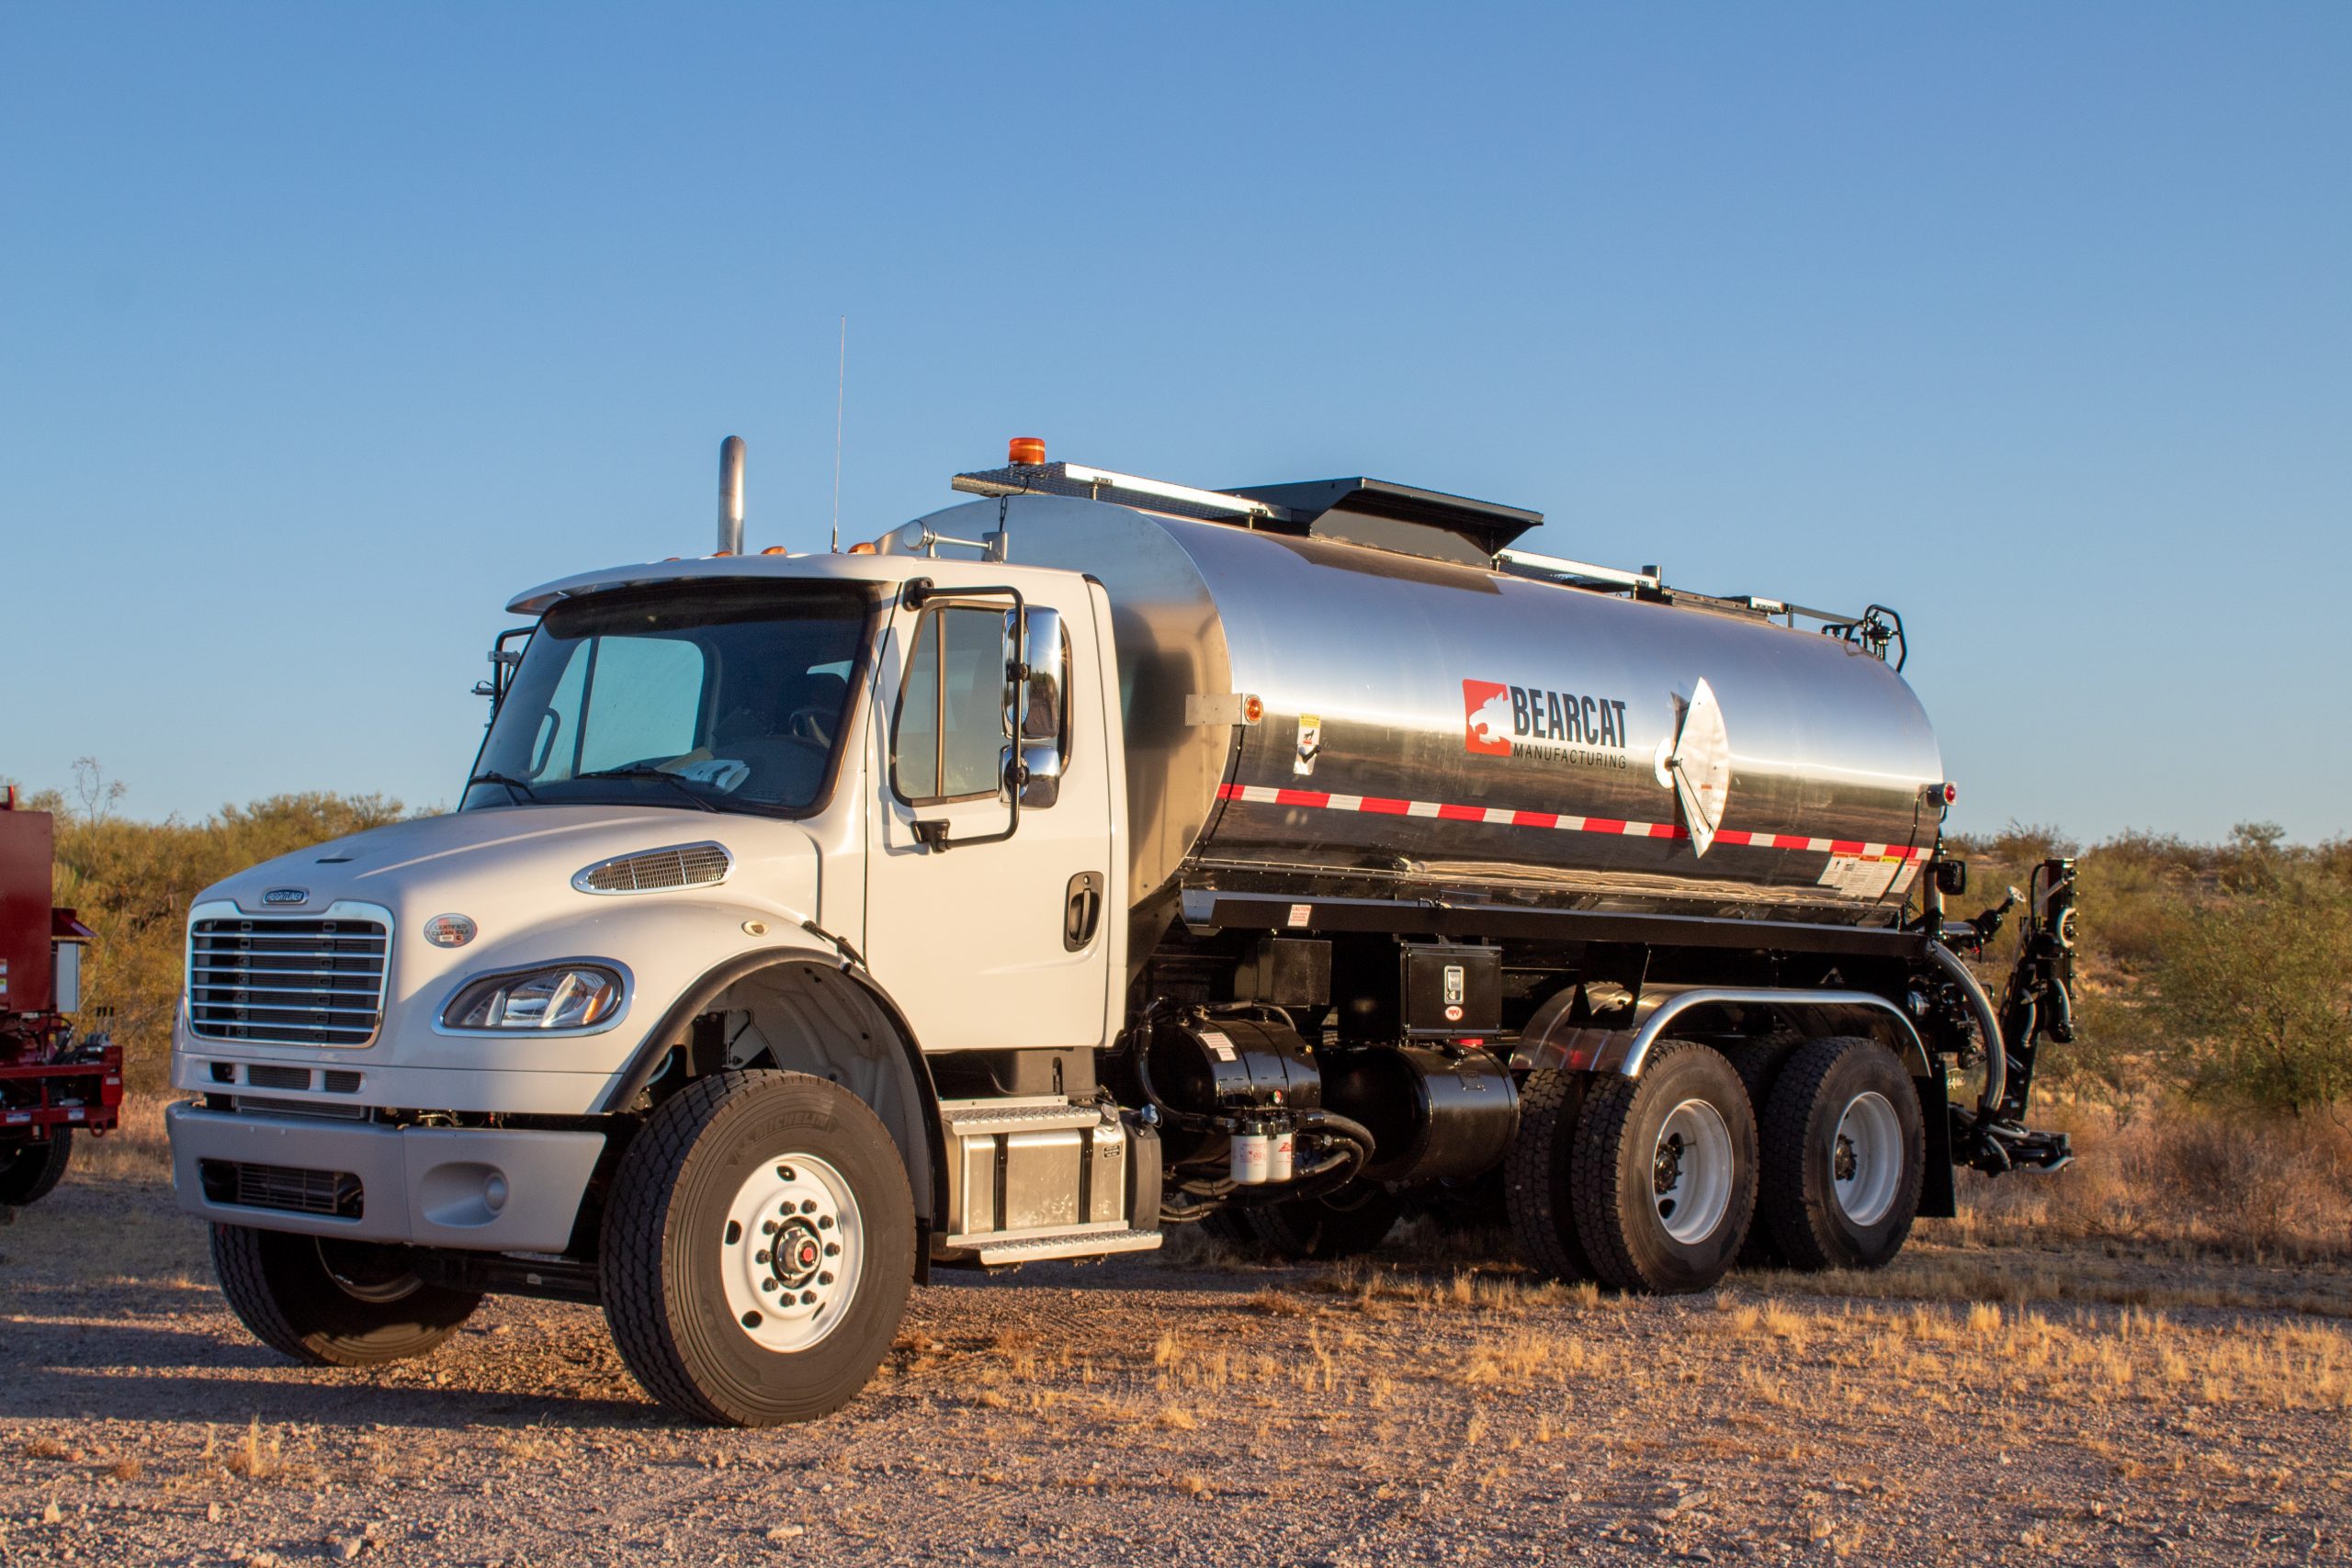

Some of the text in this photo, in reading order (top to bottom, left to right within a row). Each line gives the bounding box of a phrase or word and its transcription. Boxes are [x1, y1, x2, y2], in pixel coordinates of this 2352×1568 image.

[1510, 685, 1626, 749] BEARCAT
[1513, 743, 1626, 770] MANUFACTURING
[266, 891, 303, 901] FREIGHTLINER
